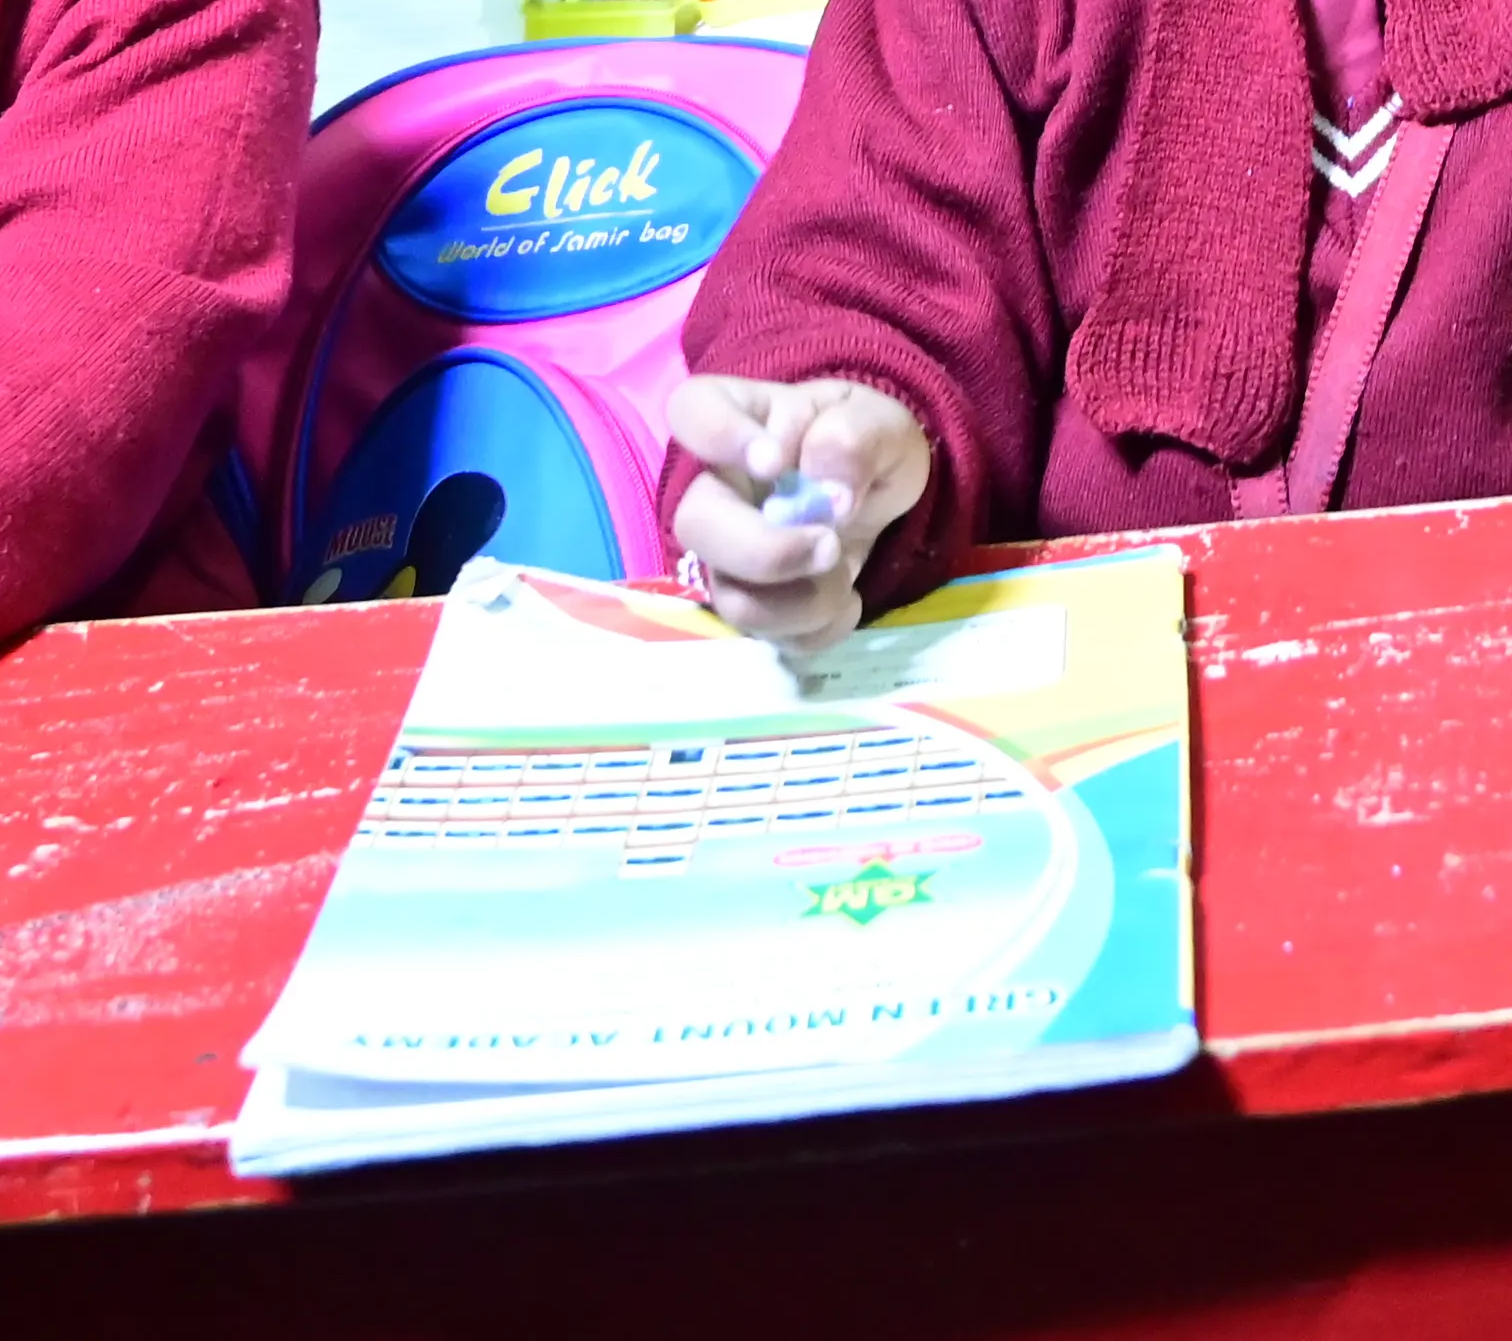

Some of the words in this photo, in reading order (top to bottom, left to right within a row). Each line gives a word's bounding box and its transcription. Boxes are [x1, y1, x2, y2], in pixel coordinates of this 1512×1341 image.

[485, 139, 660, 219] Click
[437, 235, 516, 264] World
[517, 230, 551, 256] of
[550, 226, 630, 254] Samir
[639, 220, 689, 245] bag
[324, 514, 397, 565] MOUSE
[649, 1007, 848, 1045] MOUNT
